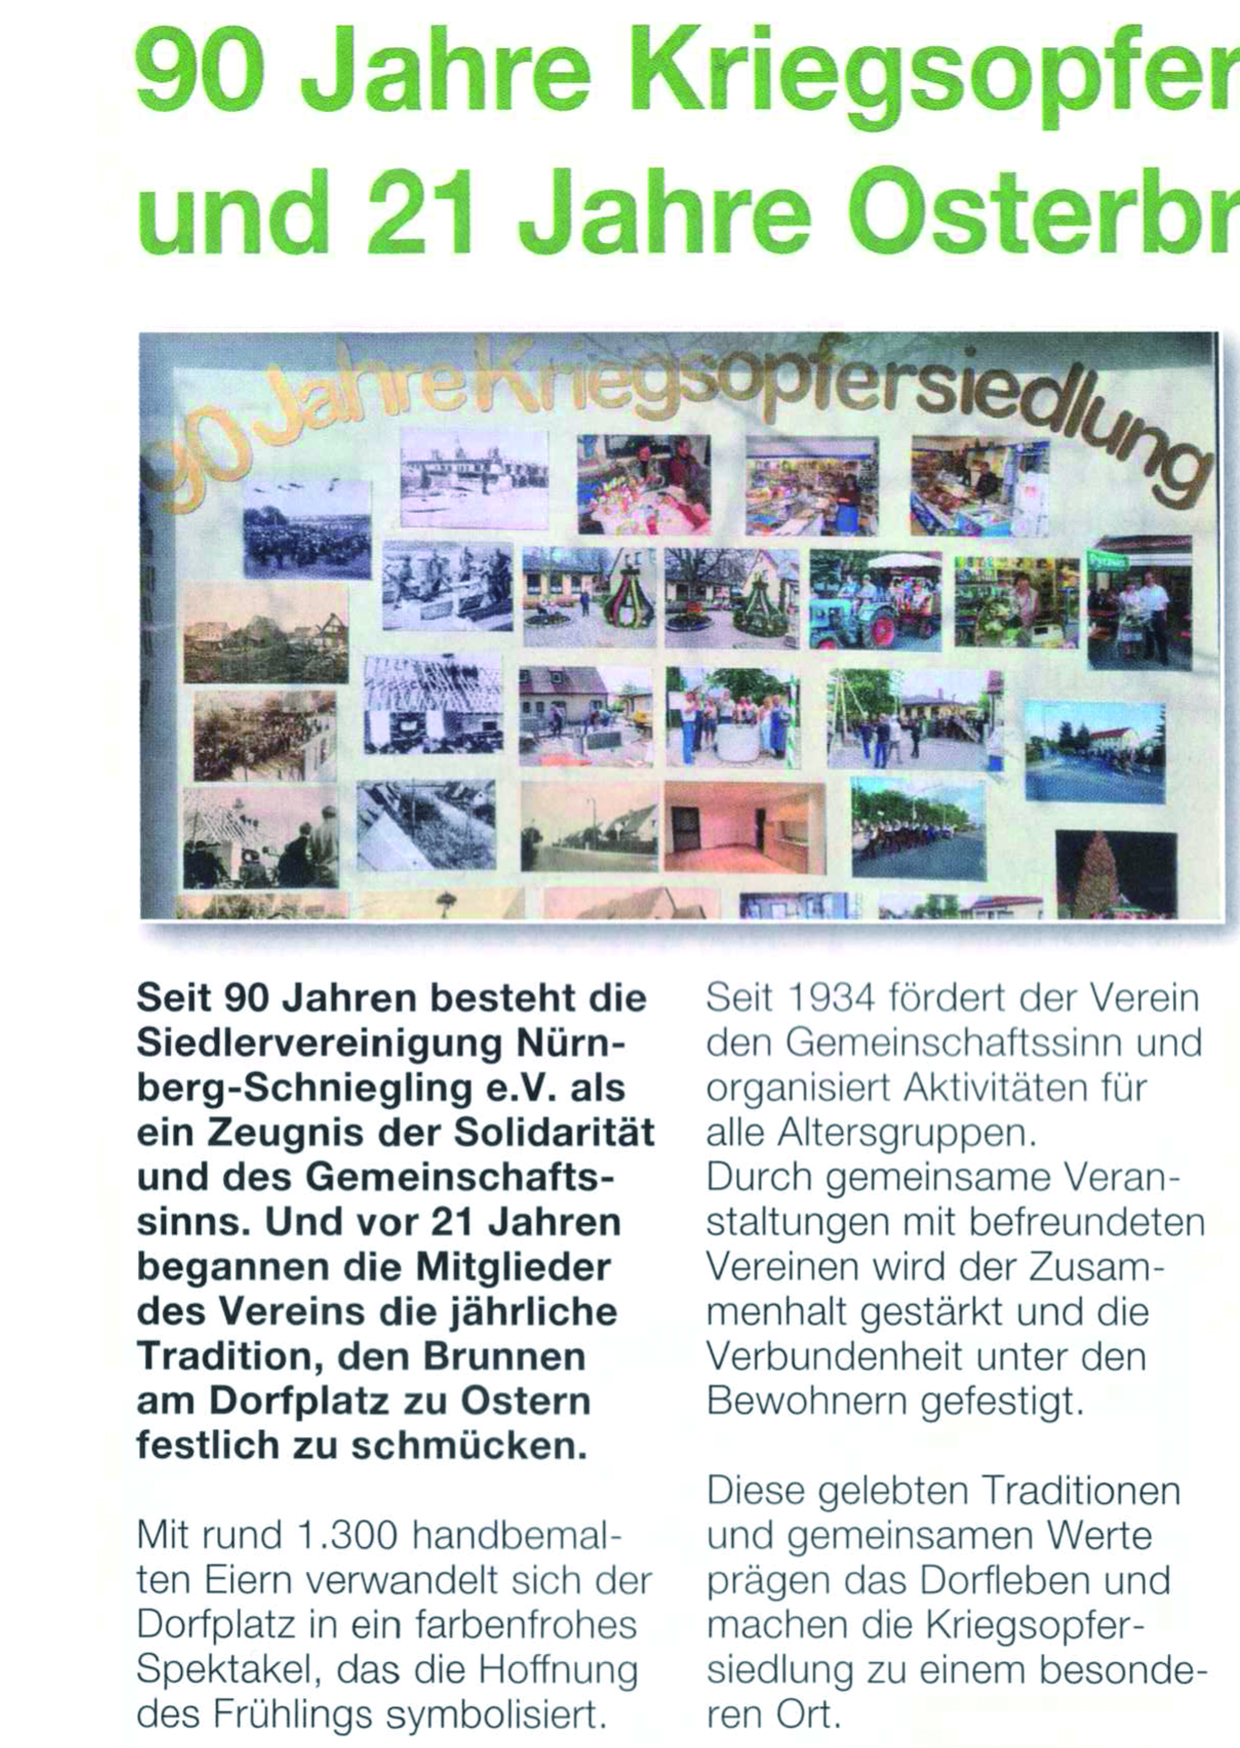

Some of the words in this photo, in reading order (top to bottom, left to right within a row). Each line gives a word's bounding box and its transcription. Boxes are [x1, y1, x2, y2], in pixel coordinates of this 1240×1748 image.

[134, 25, 265, 113] 90
[300, 24, 591, 113] Jahre
[138, 168, 329, 256] und
[368, 168, 471, 255] 21
[518, 166, 812, 256] Jahre
[253, 338, 467, 447] Jahre
[473, 333, 1216, 511] Kriegsopfersiedlung
[136, 980, 212, 1013] Seit
[224, 981, 270, 1013] 90
[282, 981, 416, 1013] Jahren
[431, 981, 576, 1013] besteht
[589, 982, 647, 1013] die
[707, 980, 772, 1012] Seit
[791, 982, 875, 1012] 1934
[889, 981, 1005, 1012] fördert
[1020, 981, 1078, 1012] der
[1090, 981, 1199, 1012] Verein
[136, 1025, 502, 1065] Siedlervereinigung
[517, 1026, 626, 1058] Nürn-
[707, 1026, 771, 1057] den
[786, 1025, 1122, 1057] Gemeinschaftssinn
[1137, 1026, 1202, 1057] und
[138, 1070, 472, 1110] berg-Schniegling
[486, 1071, 556, 1102] e.V.
[570, 1071, 626, 1103] als
[706, 1073, 890, 1110] organisiert
[903, 1071, 1087, 1102] Aktivitäten
[1101, 1071, 1148, 1102] für
[137, 1116, 194, 1147] ein
[207, 1116, 364, 1155] Zeugnis
[378, 1116, 442, 1148] der
[454, 1115, 655, 1148] Solidarität
[706, 1116, 765, 1147] alle
[777, 1116, 1036, 1155] Altersgruppen.
[138, 1160, 208, 1192] und
[222, 1160, 292, 1192] des
[306, 1160, 614, 1192] Gemeinschafts-
[708, 1160, 812, 1192] Durch
[826, 1160, 1051, 1199] gemeinsame
[1064, 1161, 1180, 1192] Veran-
[137, 1205, 250, 1237] sinns.
[266, 1205, 343, 1237] Und
[356, 1213, 420, 1237] vor
[431, 1205, 471, 1236] 21
[488, 1205, 621, 1237] Jahren
[706, 1205, 889, 1244] staltungen
[904, 1205, 956, 1236] mit
[970, 1205, 1205, 1237] befreundeten
[137, 1250, 329, 1289] begannen
[343, 1250, 402, 1282] die
[417, 1250, 612, 1289] Mitglieder
[705, 1250, 858, 1282] Vereinen
[872, 1250, 945, 1282] wird
[959, 1250, 1018, 1282] der
[1029, 1250, 1165, 1282] Zusam-
[137, 1294, 206, 1326] des
[218, 1295, 365, 1326] Vereins
[379, 1295, 437, 1327] die
[448, 1295, 618, 1333] jährliche
[707, 1295, 847, 1326] menhalt
[860, 1295, 1003, 1334] gestärkt
[1017, 1295, 1083, 1327] und
[1097, 1295, 1149, 1327] die
[136, 1339, 323, 1377] Tradition,
[337, 1340, 409, 1372] den
[424, 1340, 585, 1371] Brunnen
[706, 1340, 963, 1371] Verbundenheit
[977, 1342, 1069, 1371] unter
[1081, 1340, 1146, 1372] den
[136, 1391, 195, 1415] am
[210, 1384, 390, 1422] Dorfplatz
[403, 1392, 447, 1415] zu
[461, 1384, 590, 1416] Ostern
[708, 1384, 907, 1416] Bewohnern
[921, 1384, 1083, 1424] gefestigt.
[135, 1428, 279, 1460] festlich
[293, 1436, 337, 1460] zu
[351, 1429, 587, 1461] schmücken.
[708, 1474, 805, 1505] Diese
[818, 1474, 968, 1513] gelebten
[981, 1474, 1180, 1506] Traditionen
[138, 1518, 189, 1549] Mit
[203, 1519, 281, 1550] rund
[299, 1518, 398, 1550] 1.300
[413, 1519, 621, 1550] handbemal-
[708, 1519, 773, 1550] und
[787, 1519, 1033, 1558] gemeinsamen
[1046, 1519, 1152, 1551] Werte
[136, 1565, 190, 1594] ten
[206, 1563, 292, 1595] Eiern
[305, 1564, 498, 1595] verwandelt
[512, 1564, 581, 1595] sich
[595, 1564, 653, 1595] der
[708, 1564, 830, 1602] prägen
[844, 1564, 907, 1595] das
[921, 1564, 1090, 1595] Dorfleben
[1105, 1564, 1170, 1595] und
[138, 1607, 296, 1646] Dorfplatz
[310, 1608, 337, 1639] in
[351, 1608, 401, 1639] ein
[415, 1608, 637, 1640] farbenfrohes
[708, 1608, 847, 1639] machen
[862, 1608, 913, 1639] die
[927, 1608, 1145, 1647] Kriegsopfer-
[137, 1651, 321, 1691] Spektakel,
[337, 1653, 400, 1685] das
[414, 1653, 466, 1684] die
[480, 1653, 638, 1692] Hoffnung
[707, 1653, 853, 1692] siedlung
[867, 1661, 906, 1684] zu
[920, 1654, 1025, 1685] einem
[1040, 1653, 1208, 1685] besonde-
[137, 1697, 200, 1729] des
[215, 1697, 373, 1737] Frühlings
[386, 1698, 606, 1737] symbolisiert.
[708, 1705, 762, 1729] ren
[777, 1697, 840, 1729] Ort.
